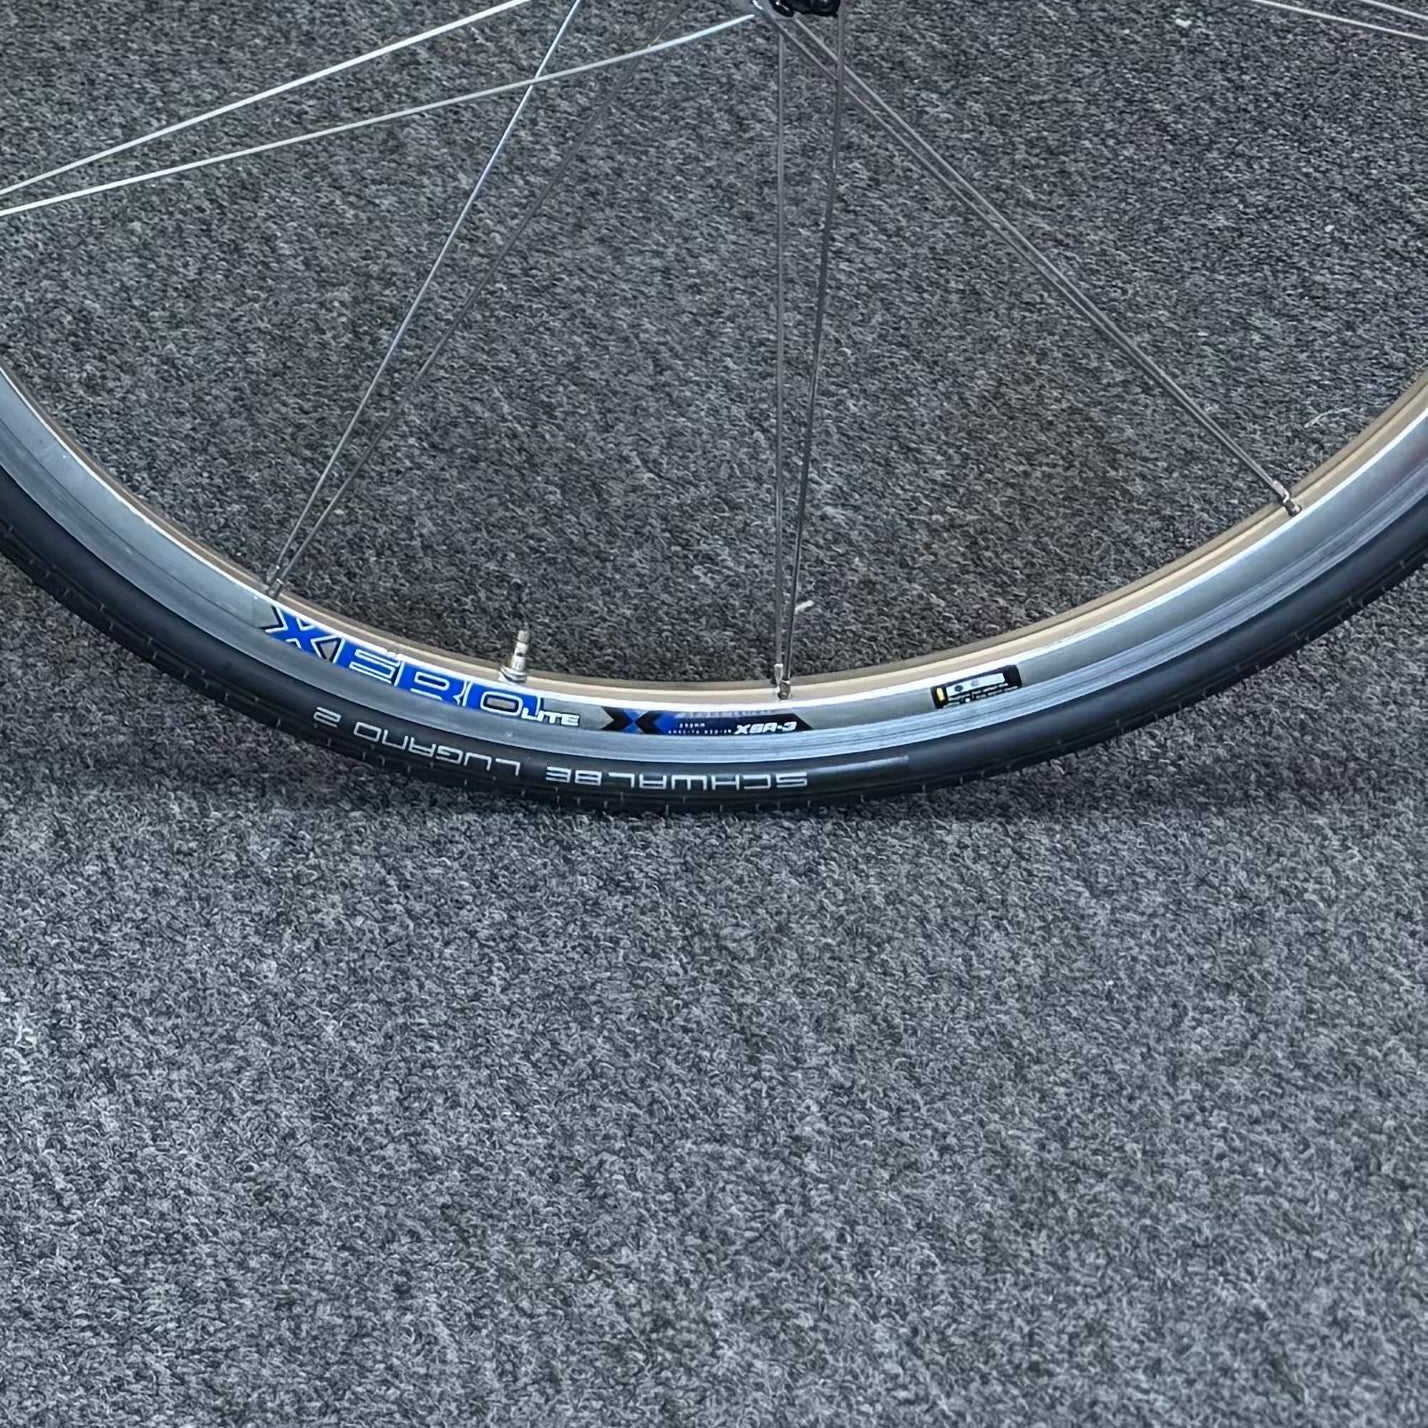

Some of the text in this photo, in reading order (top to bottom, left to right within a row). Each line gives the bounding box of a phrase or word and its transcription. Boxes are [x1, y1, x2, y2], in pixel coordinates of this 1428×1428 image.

[263, 605, 581, 727] XERO LITE
[313, 705, 809, 792] SCHWALBE LUGANO 2
